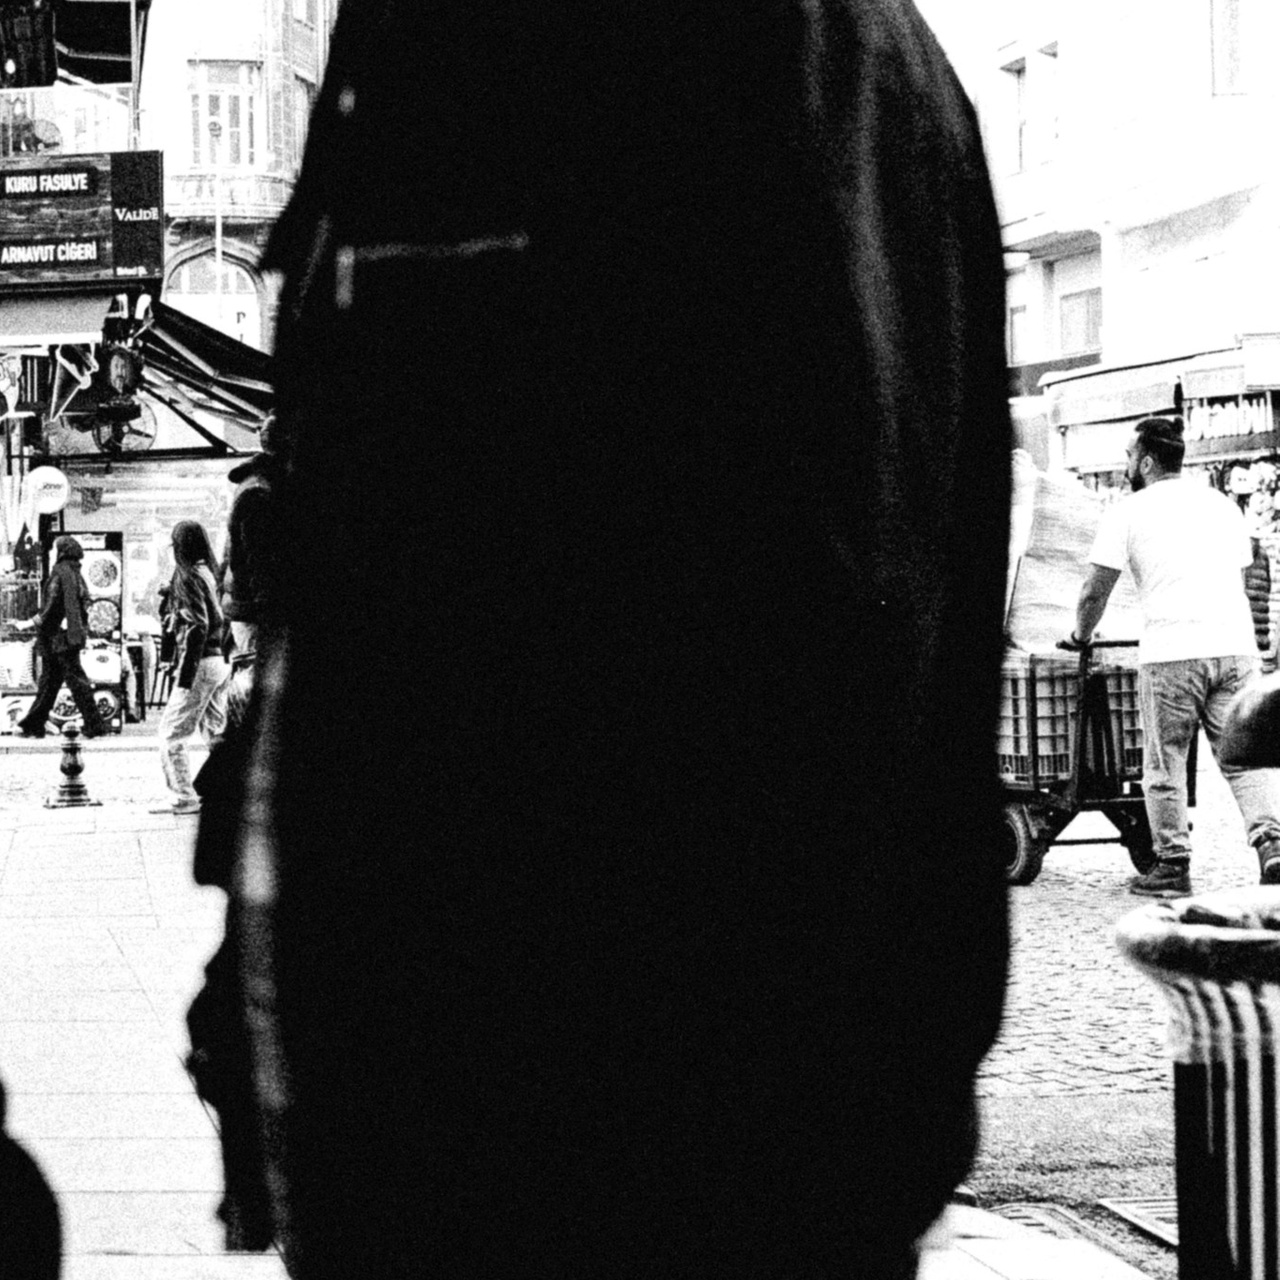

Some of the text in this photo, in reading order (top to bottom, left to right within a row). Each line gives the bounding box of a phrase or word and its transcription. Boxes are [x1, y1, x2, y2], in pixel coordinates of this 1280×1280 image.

[5, 172, 89, 194] KURU FASULYE
[1, 245, 55, 264] ARNAVUT
